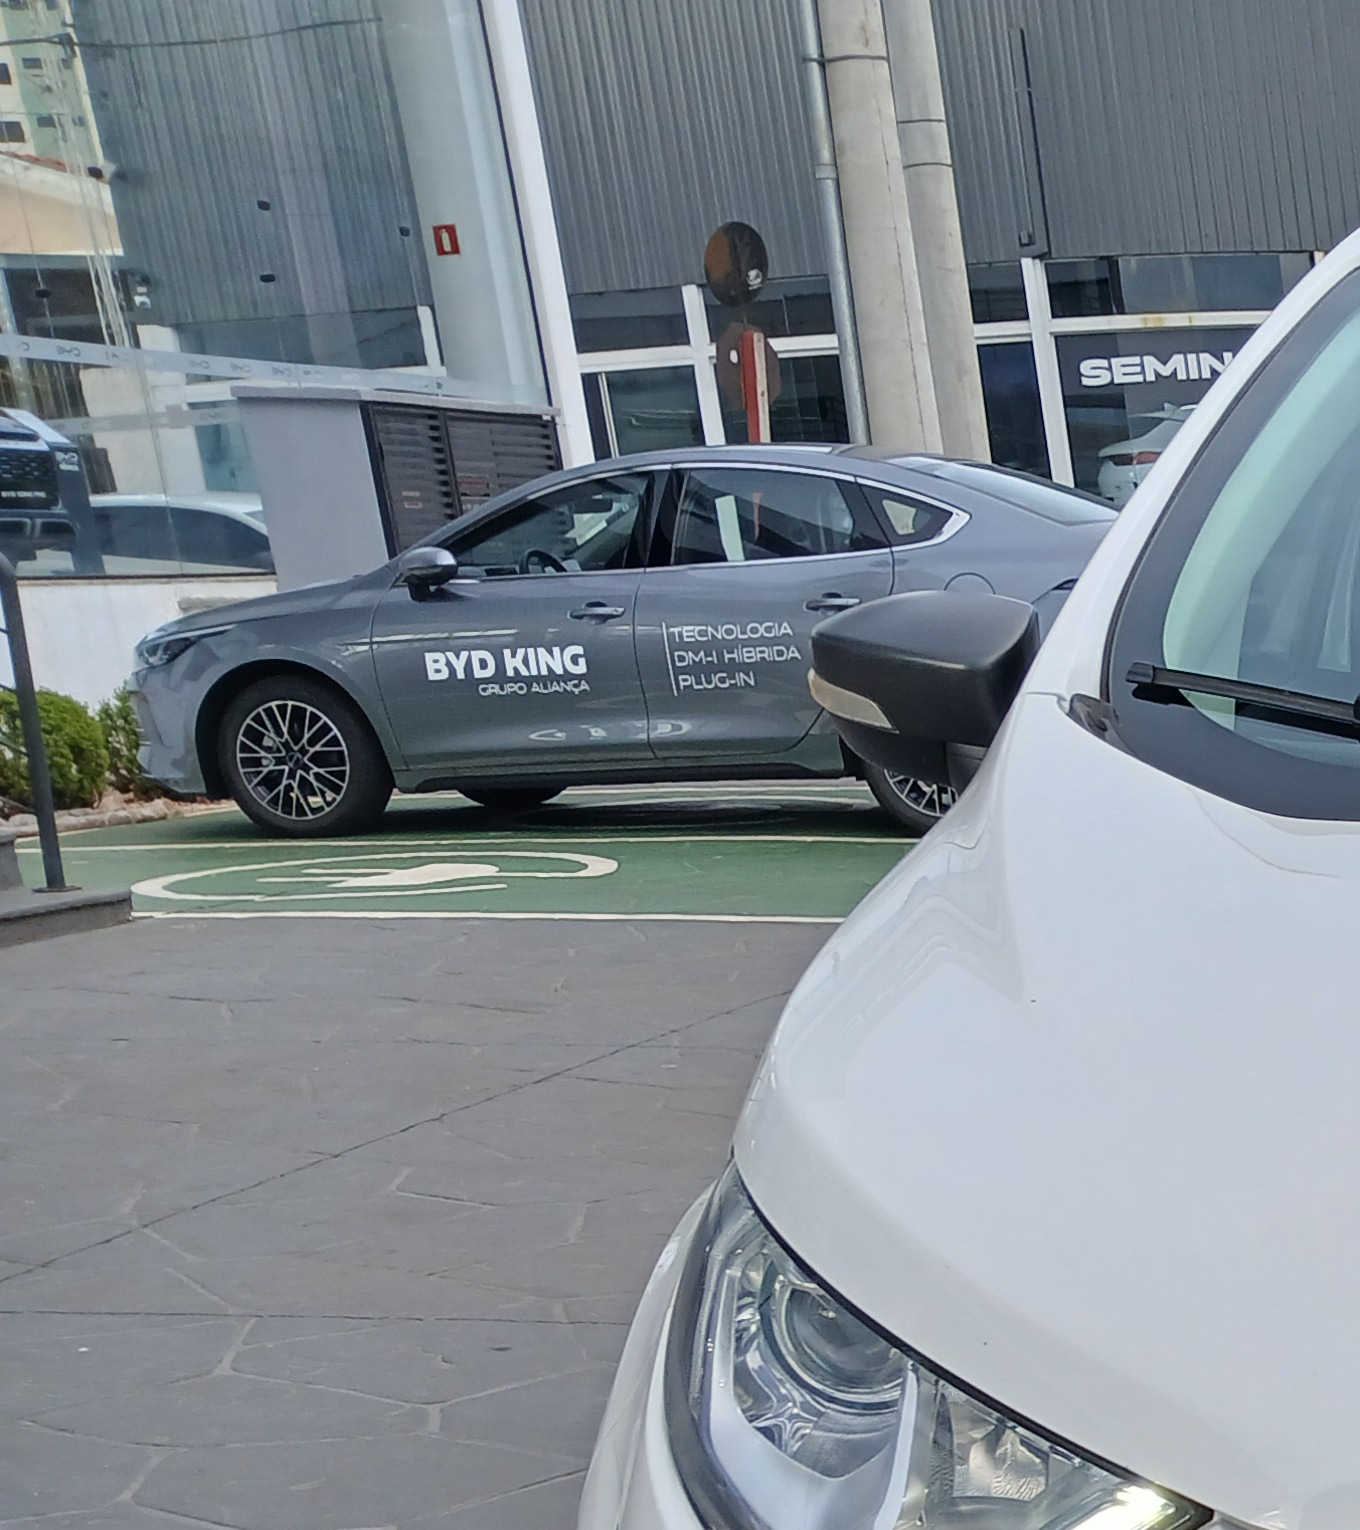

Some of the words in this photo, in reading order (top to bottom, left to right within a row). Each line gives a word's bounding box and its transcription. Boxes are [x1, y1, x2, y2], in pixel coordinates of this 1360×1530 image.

[669, 621, 793, 642] TECNOLOGIA
[424, 650, 496, 681] BYD
[503, 645, 588, 677] KING
[674, 649, 717, 667] DM-I
[723, 644, 802, 664] HÍBRIDA
[478, 682, 527, 697] GRUPO
[678, 670, 755, 692] PLUG-IN
